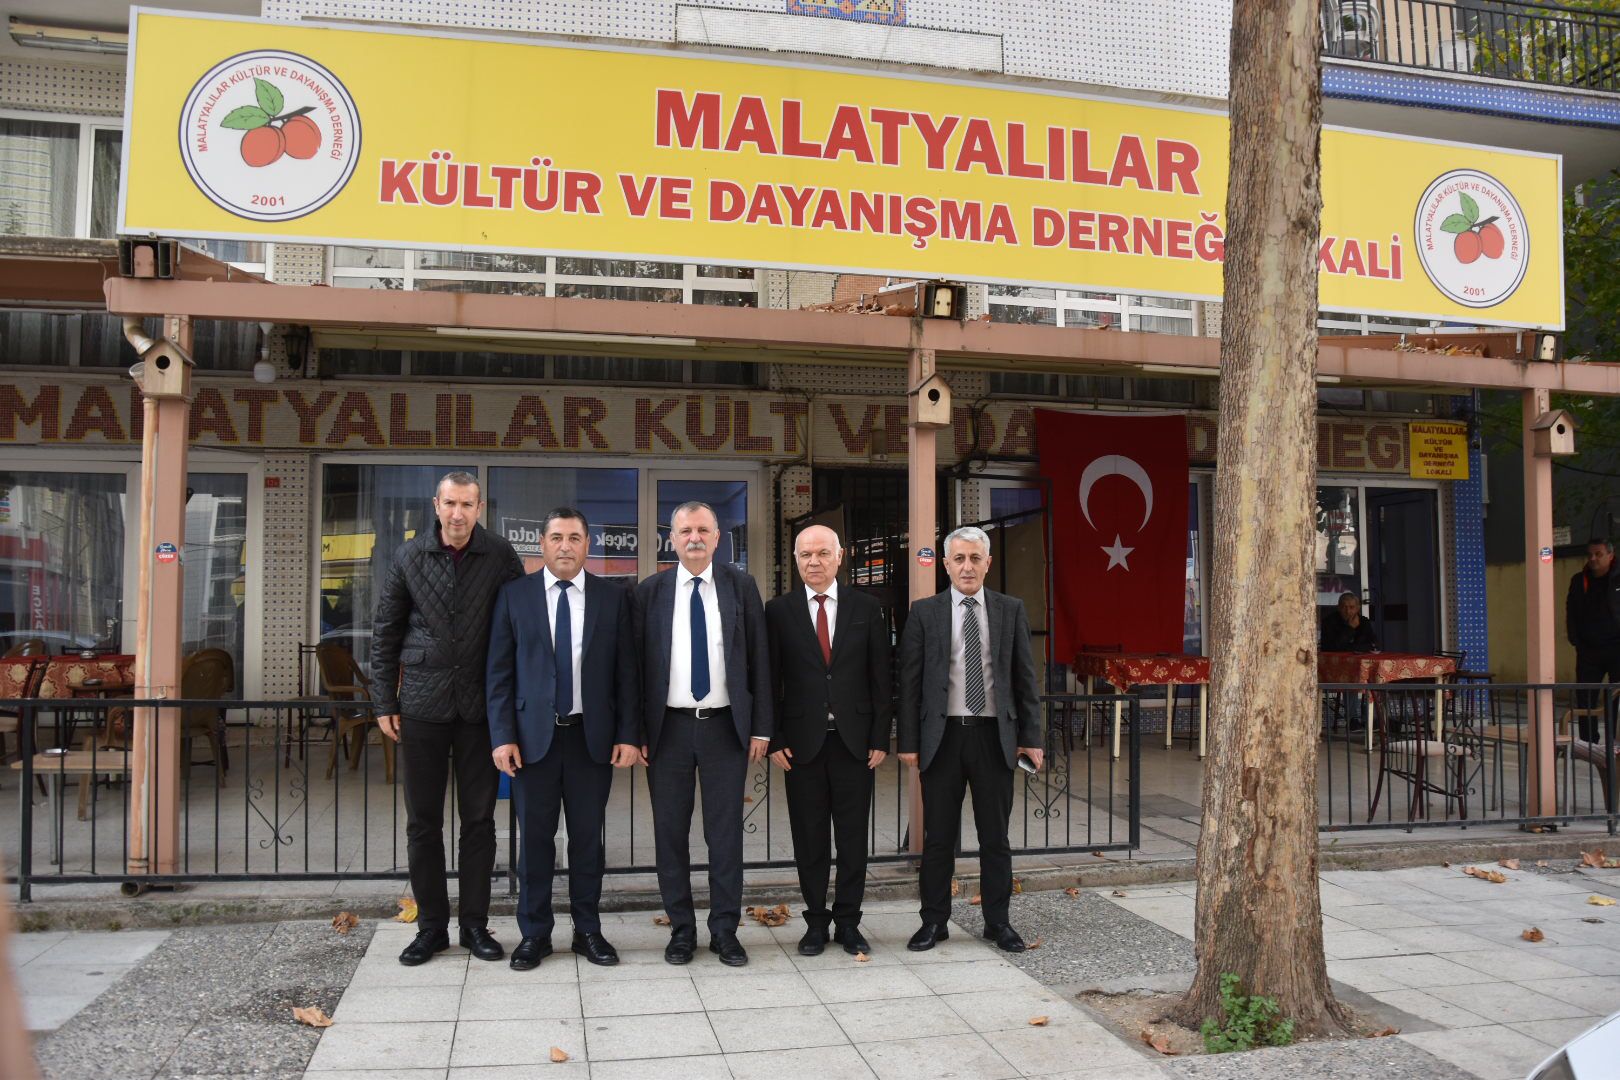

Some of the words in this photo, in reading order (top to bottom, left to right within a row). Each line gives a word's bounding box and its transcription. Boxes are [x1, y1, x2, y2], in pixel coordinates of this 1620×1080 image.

[196, 81, 231, 153] MALATYALILAR
[230, 65, 271, 85] KÜLTÜR
[274, 66, 287, 77] VE
[290, 70, 336, 115] DAYANIŞMA
[657, 89, 1200, 195] MALATYALILAR
[251, 194, 286, 207] 2001
[1471, 183, 1480, 191] VE
[381, 151, 602, 214] KÜLTÜR
[619, 175, 692, 219] VE
[710, 181, 1018, 249] DAYANIŞMA
[1034, 207, 1225, 262] DERNEĞ
[1317, 234, 1402, 280] KALİ
[1463, 286, 1486, 296] 2001
